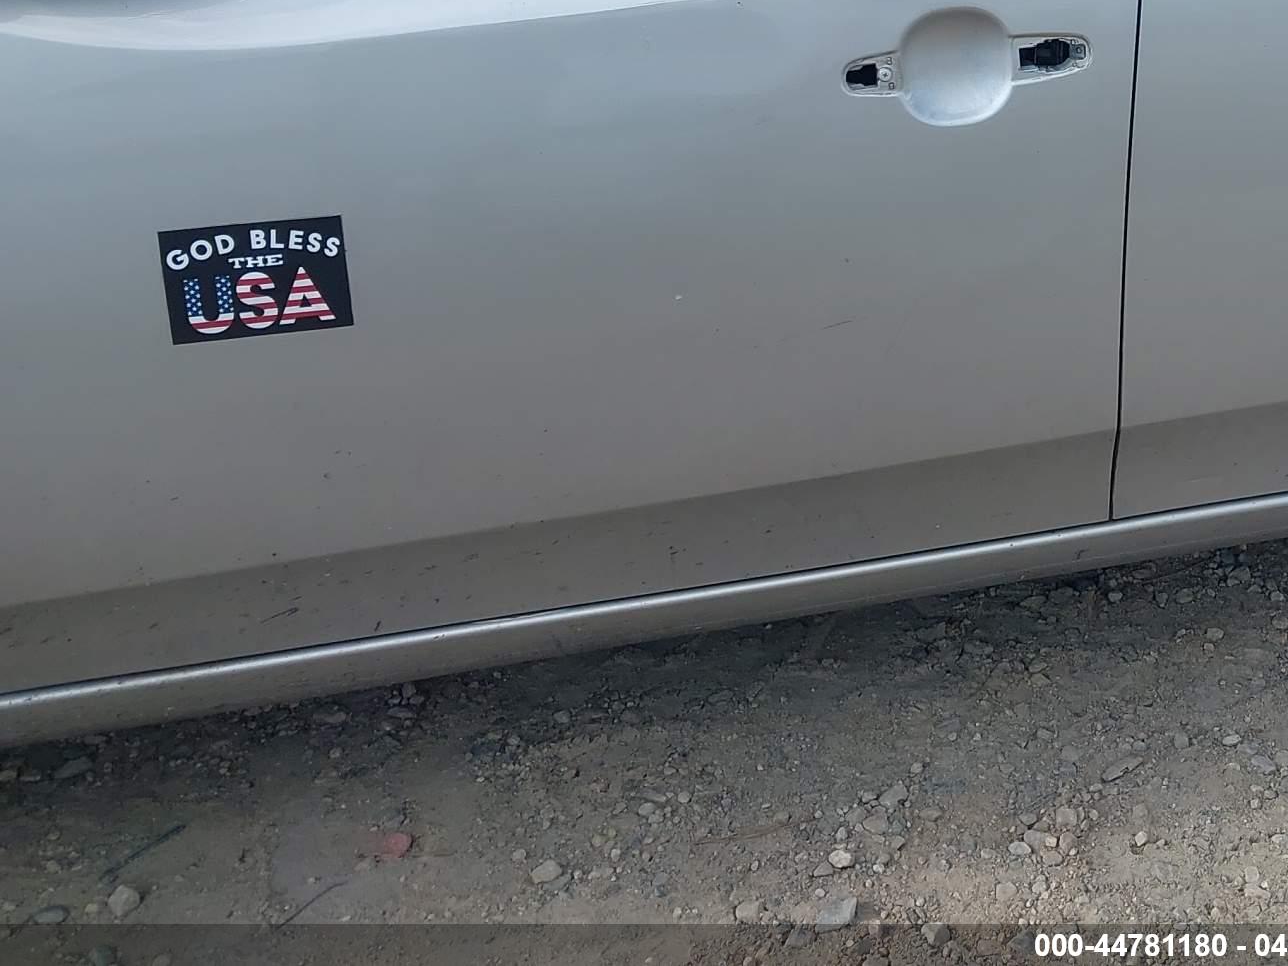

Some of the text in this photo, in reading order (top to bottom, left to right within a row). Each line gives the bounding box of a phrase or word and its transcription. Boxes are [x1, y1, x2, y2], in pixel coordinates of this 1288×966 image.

[166, 229, 341, 271] GOD BLESS
[228, 253, 284, 269] THE
[183, 266, 336, 335] USA
